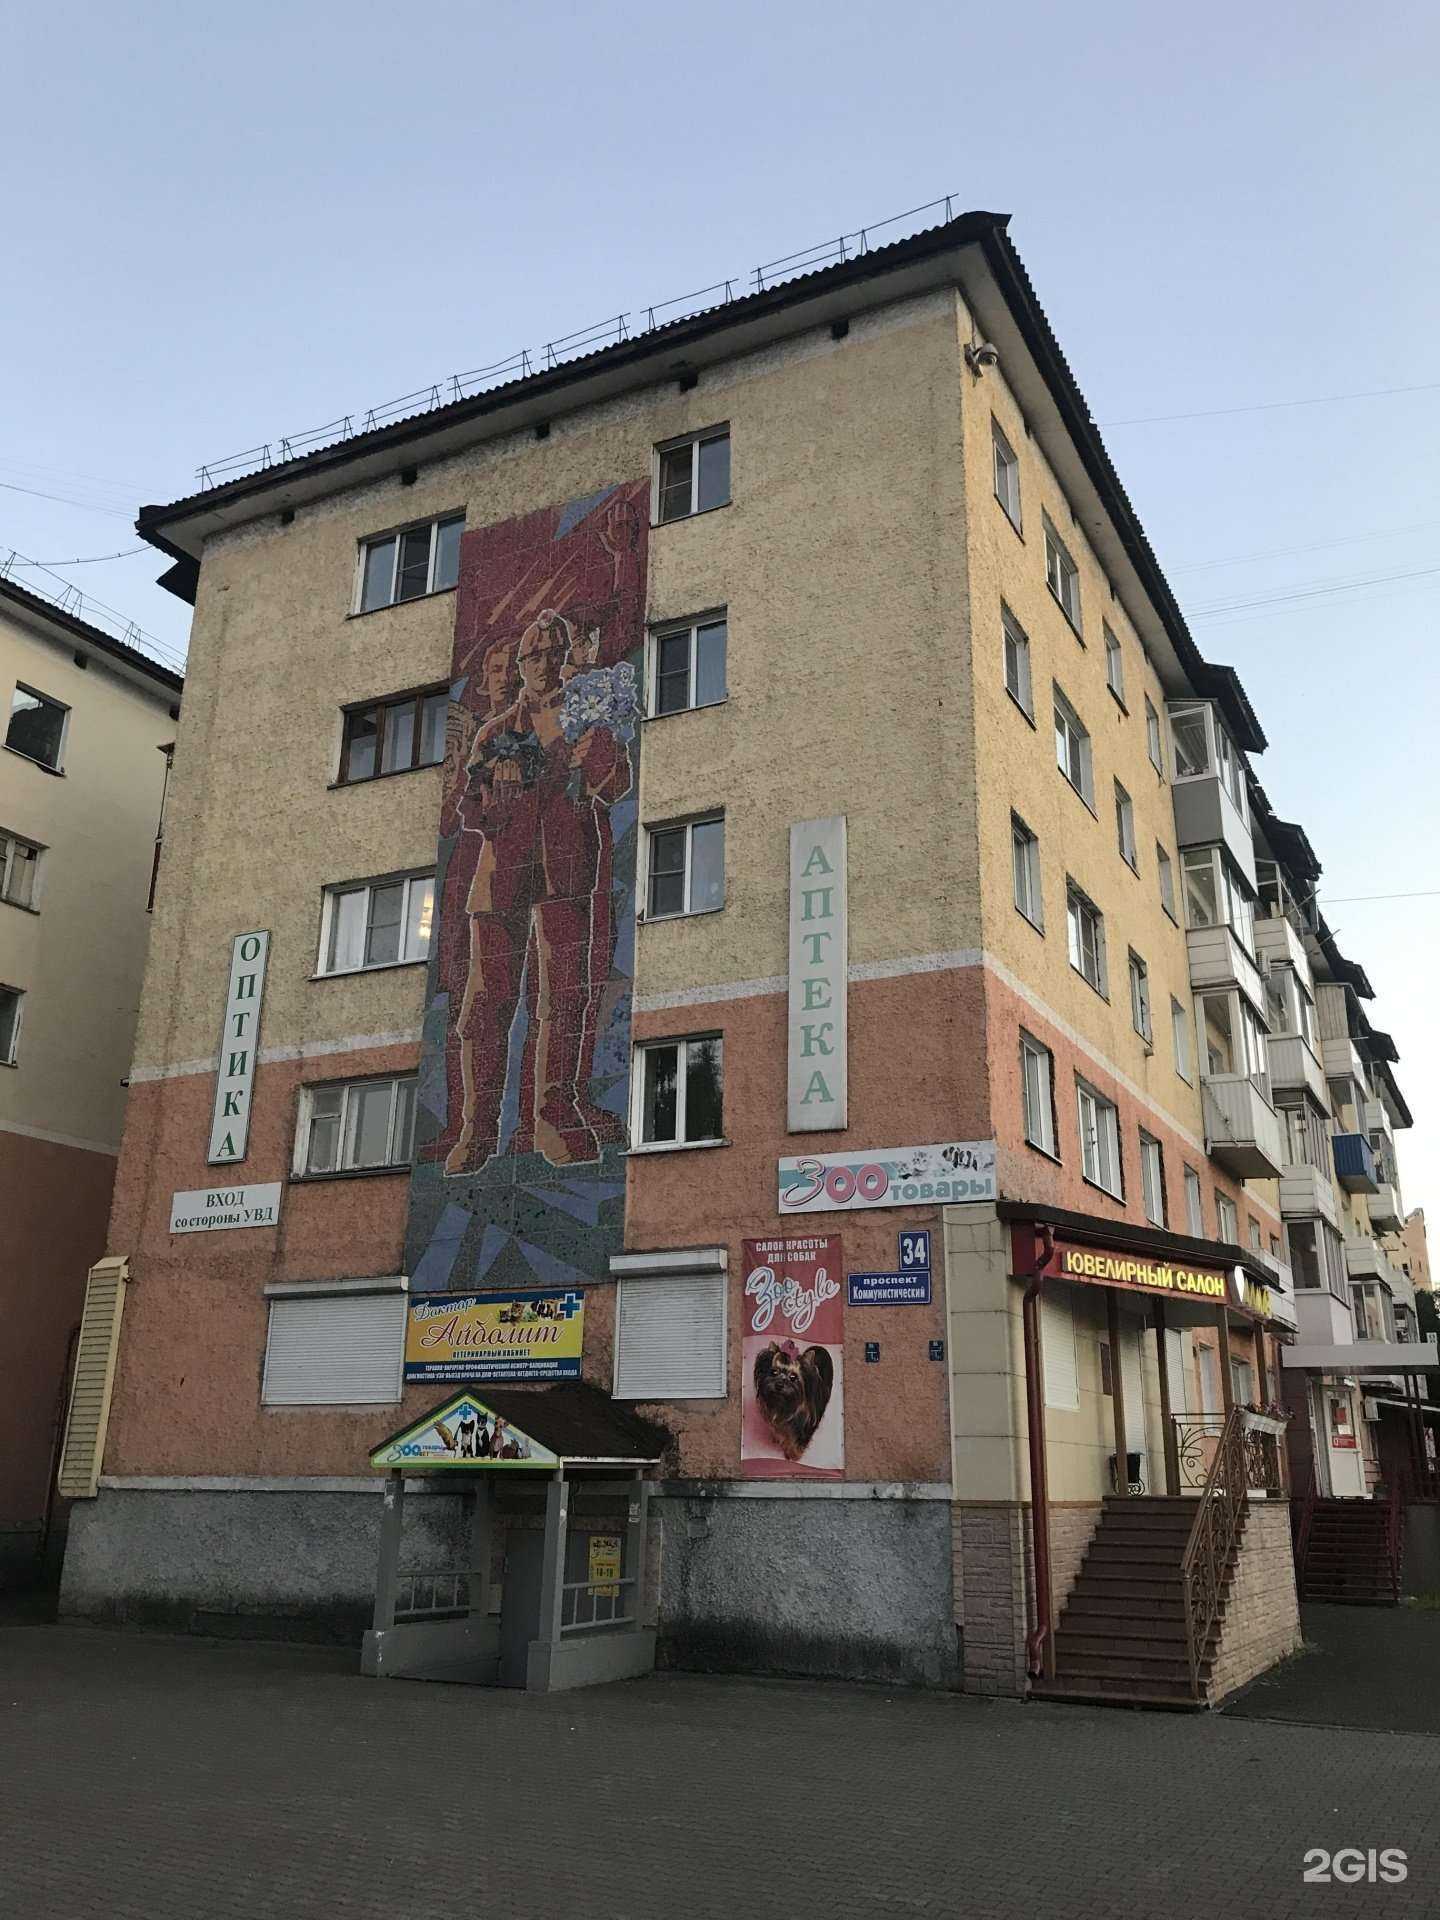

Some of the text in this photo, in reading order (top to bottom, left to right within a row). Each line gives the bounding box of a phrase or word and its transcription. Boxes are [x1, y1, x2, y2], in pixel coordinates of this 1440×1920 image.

[799, 845, 835, 1105] АПТЕКА
[216, 937, 261, 1158] ОПТИКА
[206, 1191, 245, 1208] ВХОД
[890, 1178, 992, 1201] товары
[243, 1207, 273, 1222] УВД
[756, 1239, 828, 1252] САЛОН КРАСОТЫ
[787, 1251, 816, 1262] СОБАК
[903, 1238, 926, 1265] 34
[863, 1276, 918, 1286] проспект
[1066, 1250, 1225, 1297] ЮВЕЛИРНЫЙ САЛОН
[853, 1286, 925, 1301] Коммунистический
[414, 1297, 477, 1321] Доктор
[420, 1315, 564, 1348] Айболит
